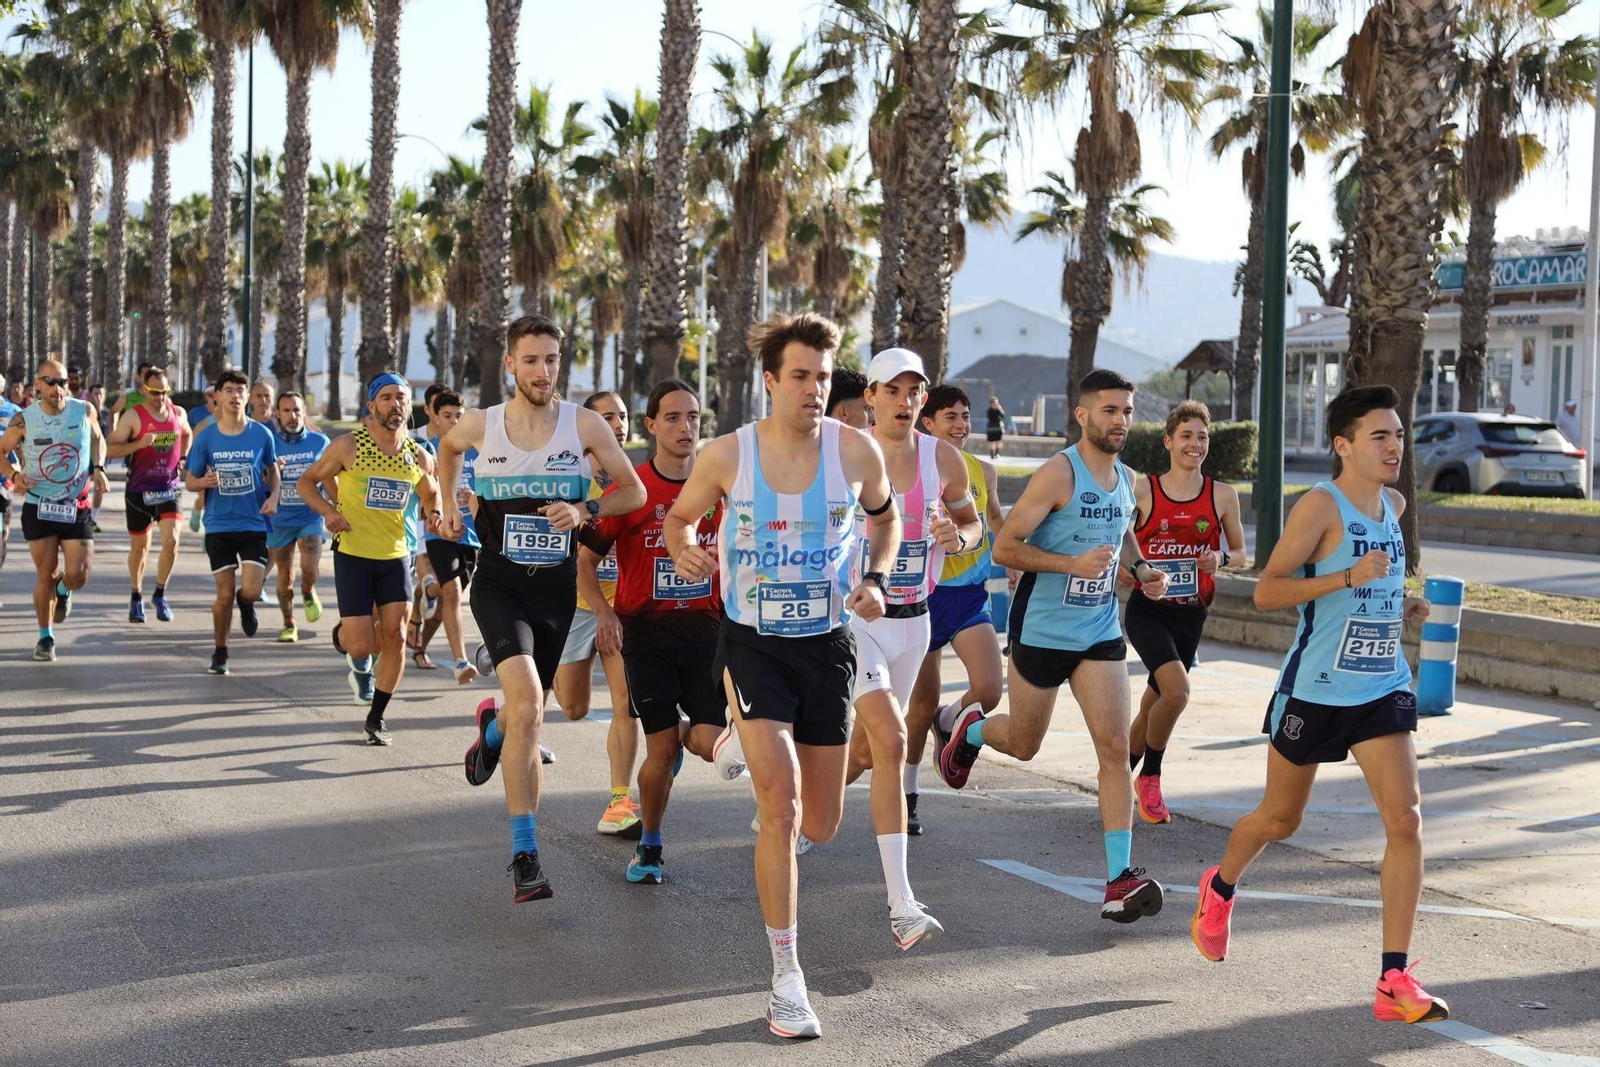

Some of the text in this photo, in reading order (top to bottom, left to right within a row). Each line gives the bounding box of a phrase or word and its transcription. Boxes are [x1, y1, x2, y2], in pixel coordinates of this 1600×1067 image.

[1493, 256, 1586, 286] ROCAMAR
[1497, 314, 1540, 325] ROCAMAR
[213, 449, 254, 460] mayoral
[488, 456, 507, 464] vive
[223, 477, 249, 486] 2210
[491, 478, 570, 497] inacua
[372, 489, 404, 501] 2053
[44, 504, 72, 514] 1669
[734, 500, 753, 508] vive
[1080, 503, 1122, 522] nerja
[513, 534, 562, 549] 1992
[1148, 543, 1211, 555] CÁRTAMA
[781, 602, 810, 618] 26
[1349, 640, 1396, 656] 2156
